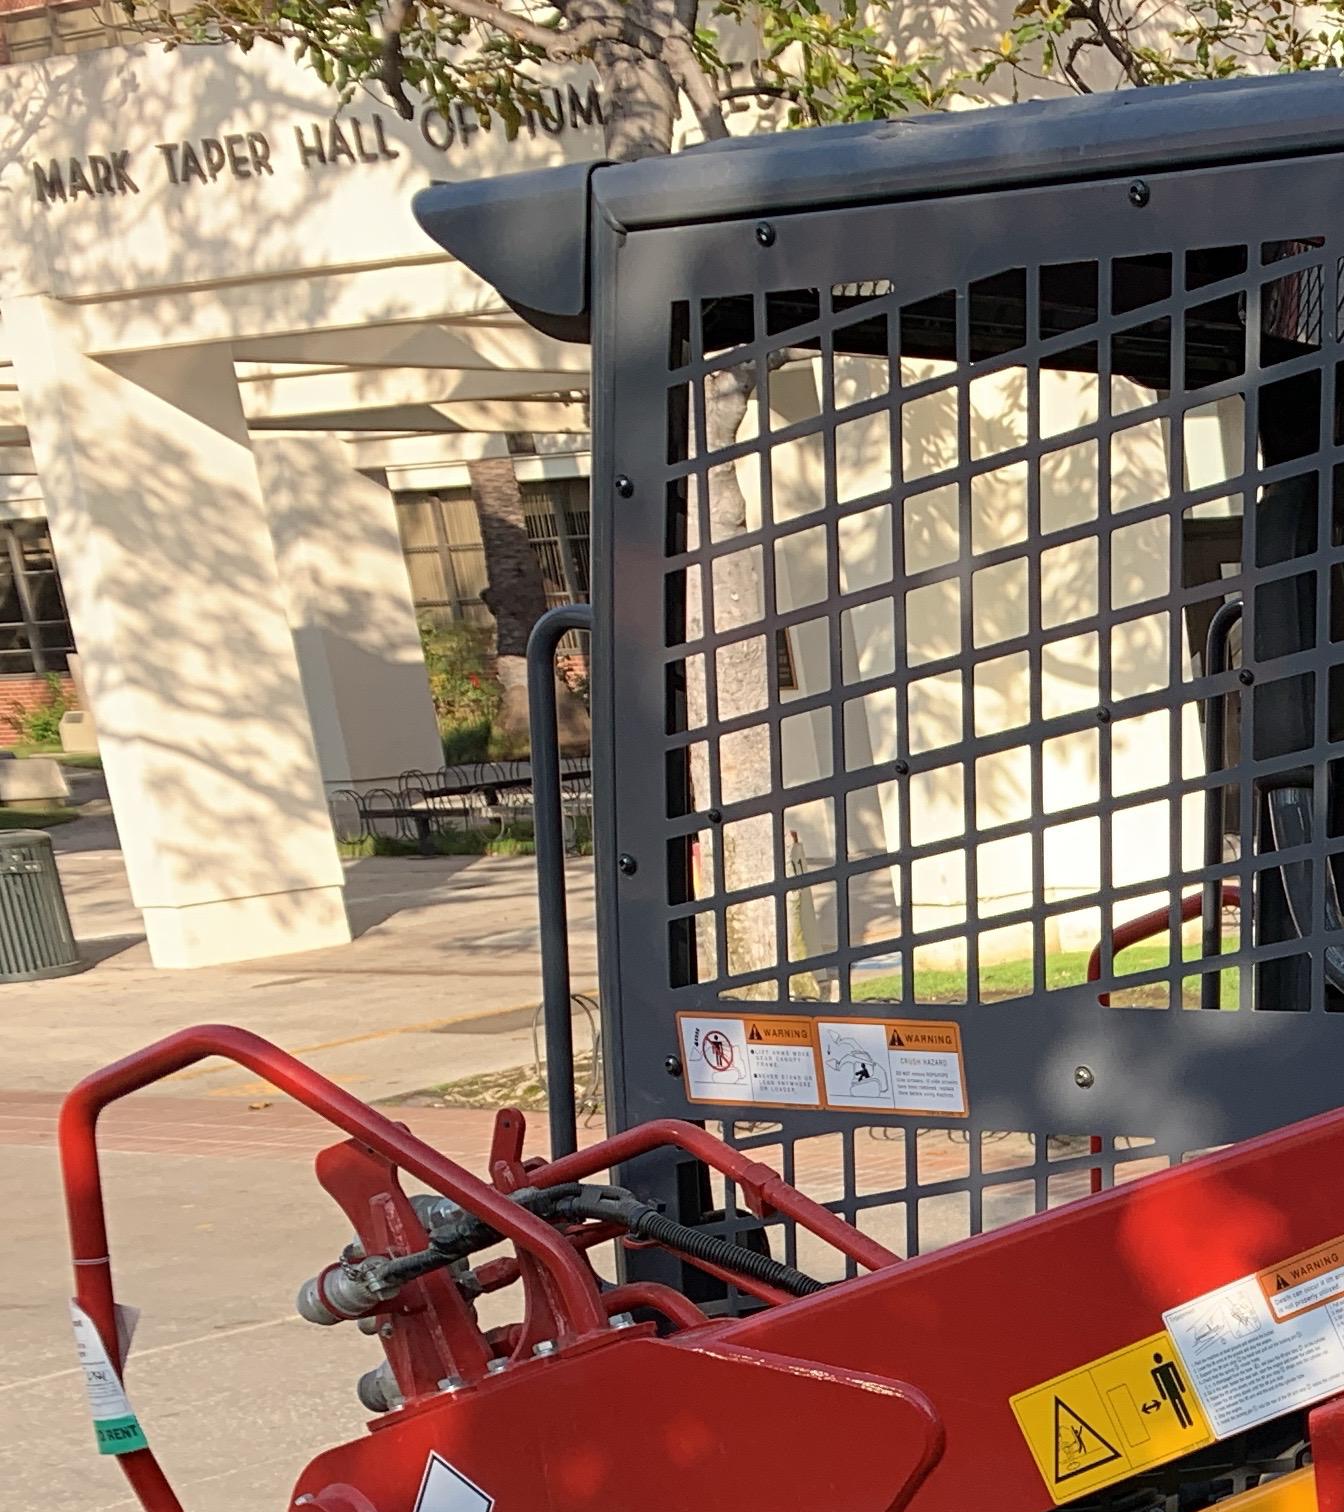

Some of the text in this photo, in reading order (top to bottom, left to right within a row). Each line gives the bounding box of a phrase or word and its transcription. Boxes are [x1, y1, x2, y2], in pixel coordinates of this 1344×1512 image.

[31, 148, 142, 206] MARK
[154, 131, 276, 187] TAPER
[293, 112, 401, 171] HALL
[420, 98, 479, 152] OF
[763, 1028, 809, 1040] WARNING
[904, 1033, 953, 1046] WARNING
[1289, 1252, 1340, 1280] WARNING
[108, 1424, 140, 1442] RENT
